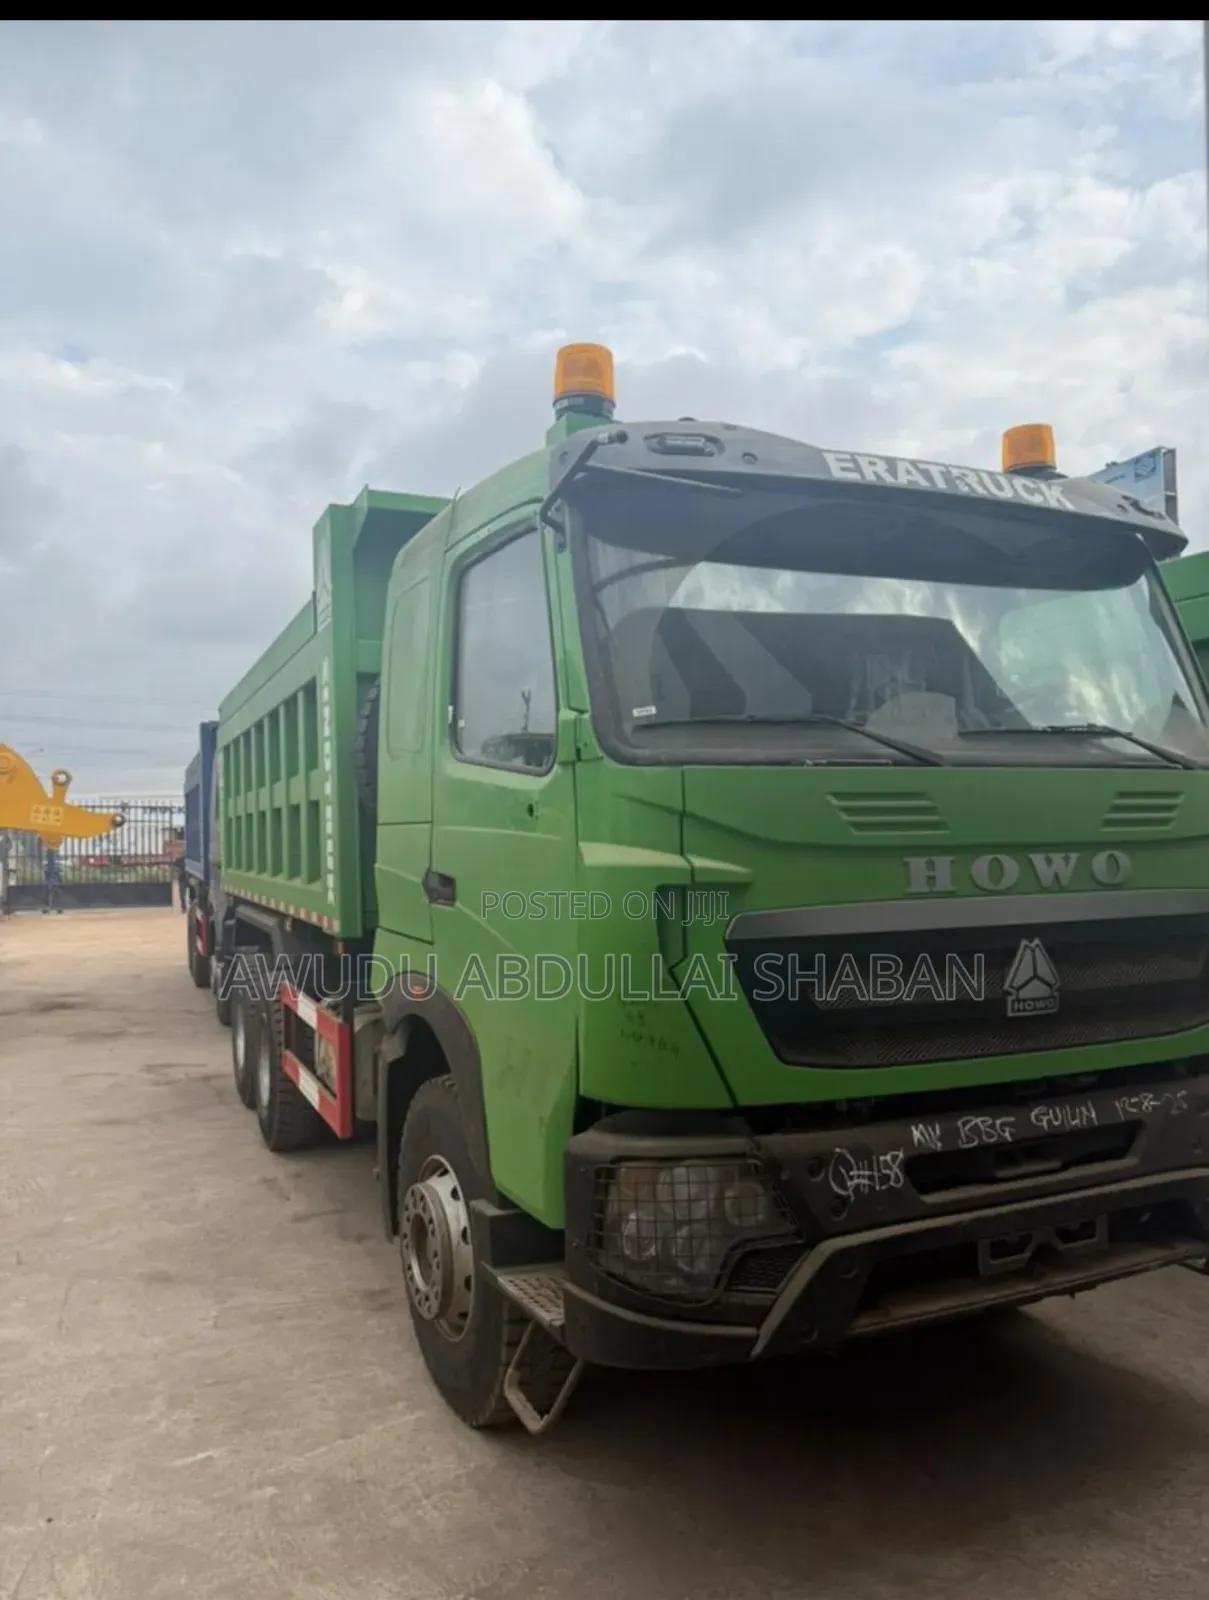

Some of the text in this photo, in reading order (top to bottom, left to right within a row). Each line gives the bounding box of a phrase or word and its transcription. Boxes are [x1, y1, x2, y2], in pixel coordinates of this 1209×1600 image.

[821, 451, 1075, 510] ERATRUCK
[904, 850, 1132, 893] HOWO
[1014, 999, 1054, 1011] HOWO
